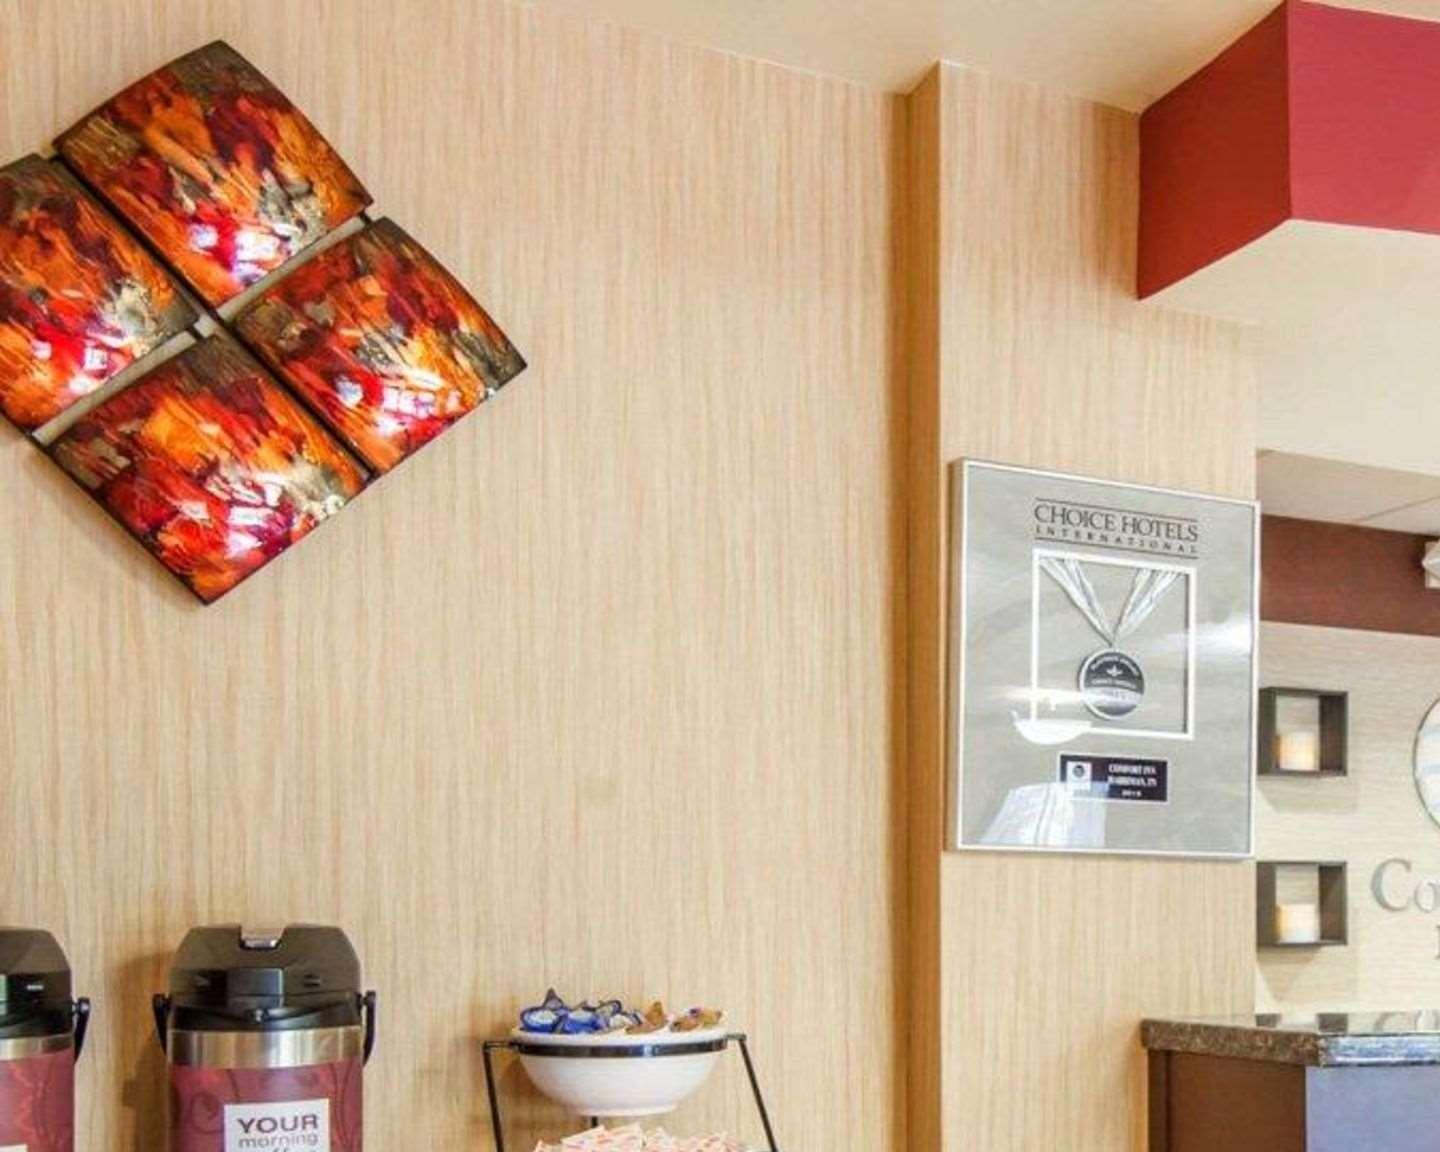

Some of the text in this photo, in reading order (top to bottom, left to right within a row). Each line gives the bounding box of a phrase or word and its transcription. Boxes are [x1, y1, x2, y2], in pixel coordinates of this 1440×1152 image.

[1034, 504, 1198, 542] CHOICE HOTELS
[1035, 524, 1196, 553] INTERNATIONAL
[237, 1114, 318, 1133] YOUR
[238, 1133, 318, 1149] morning
